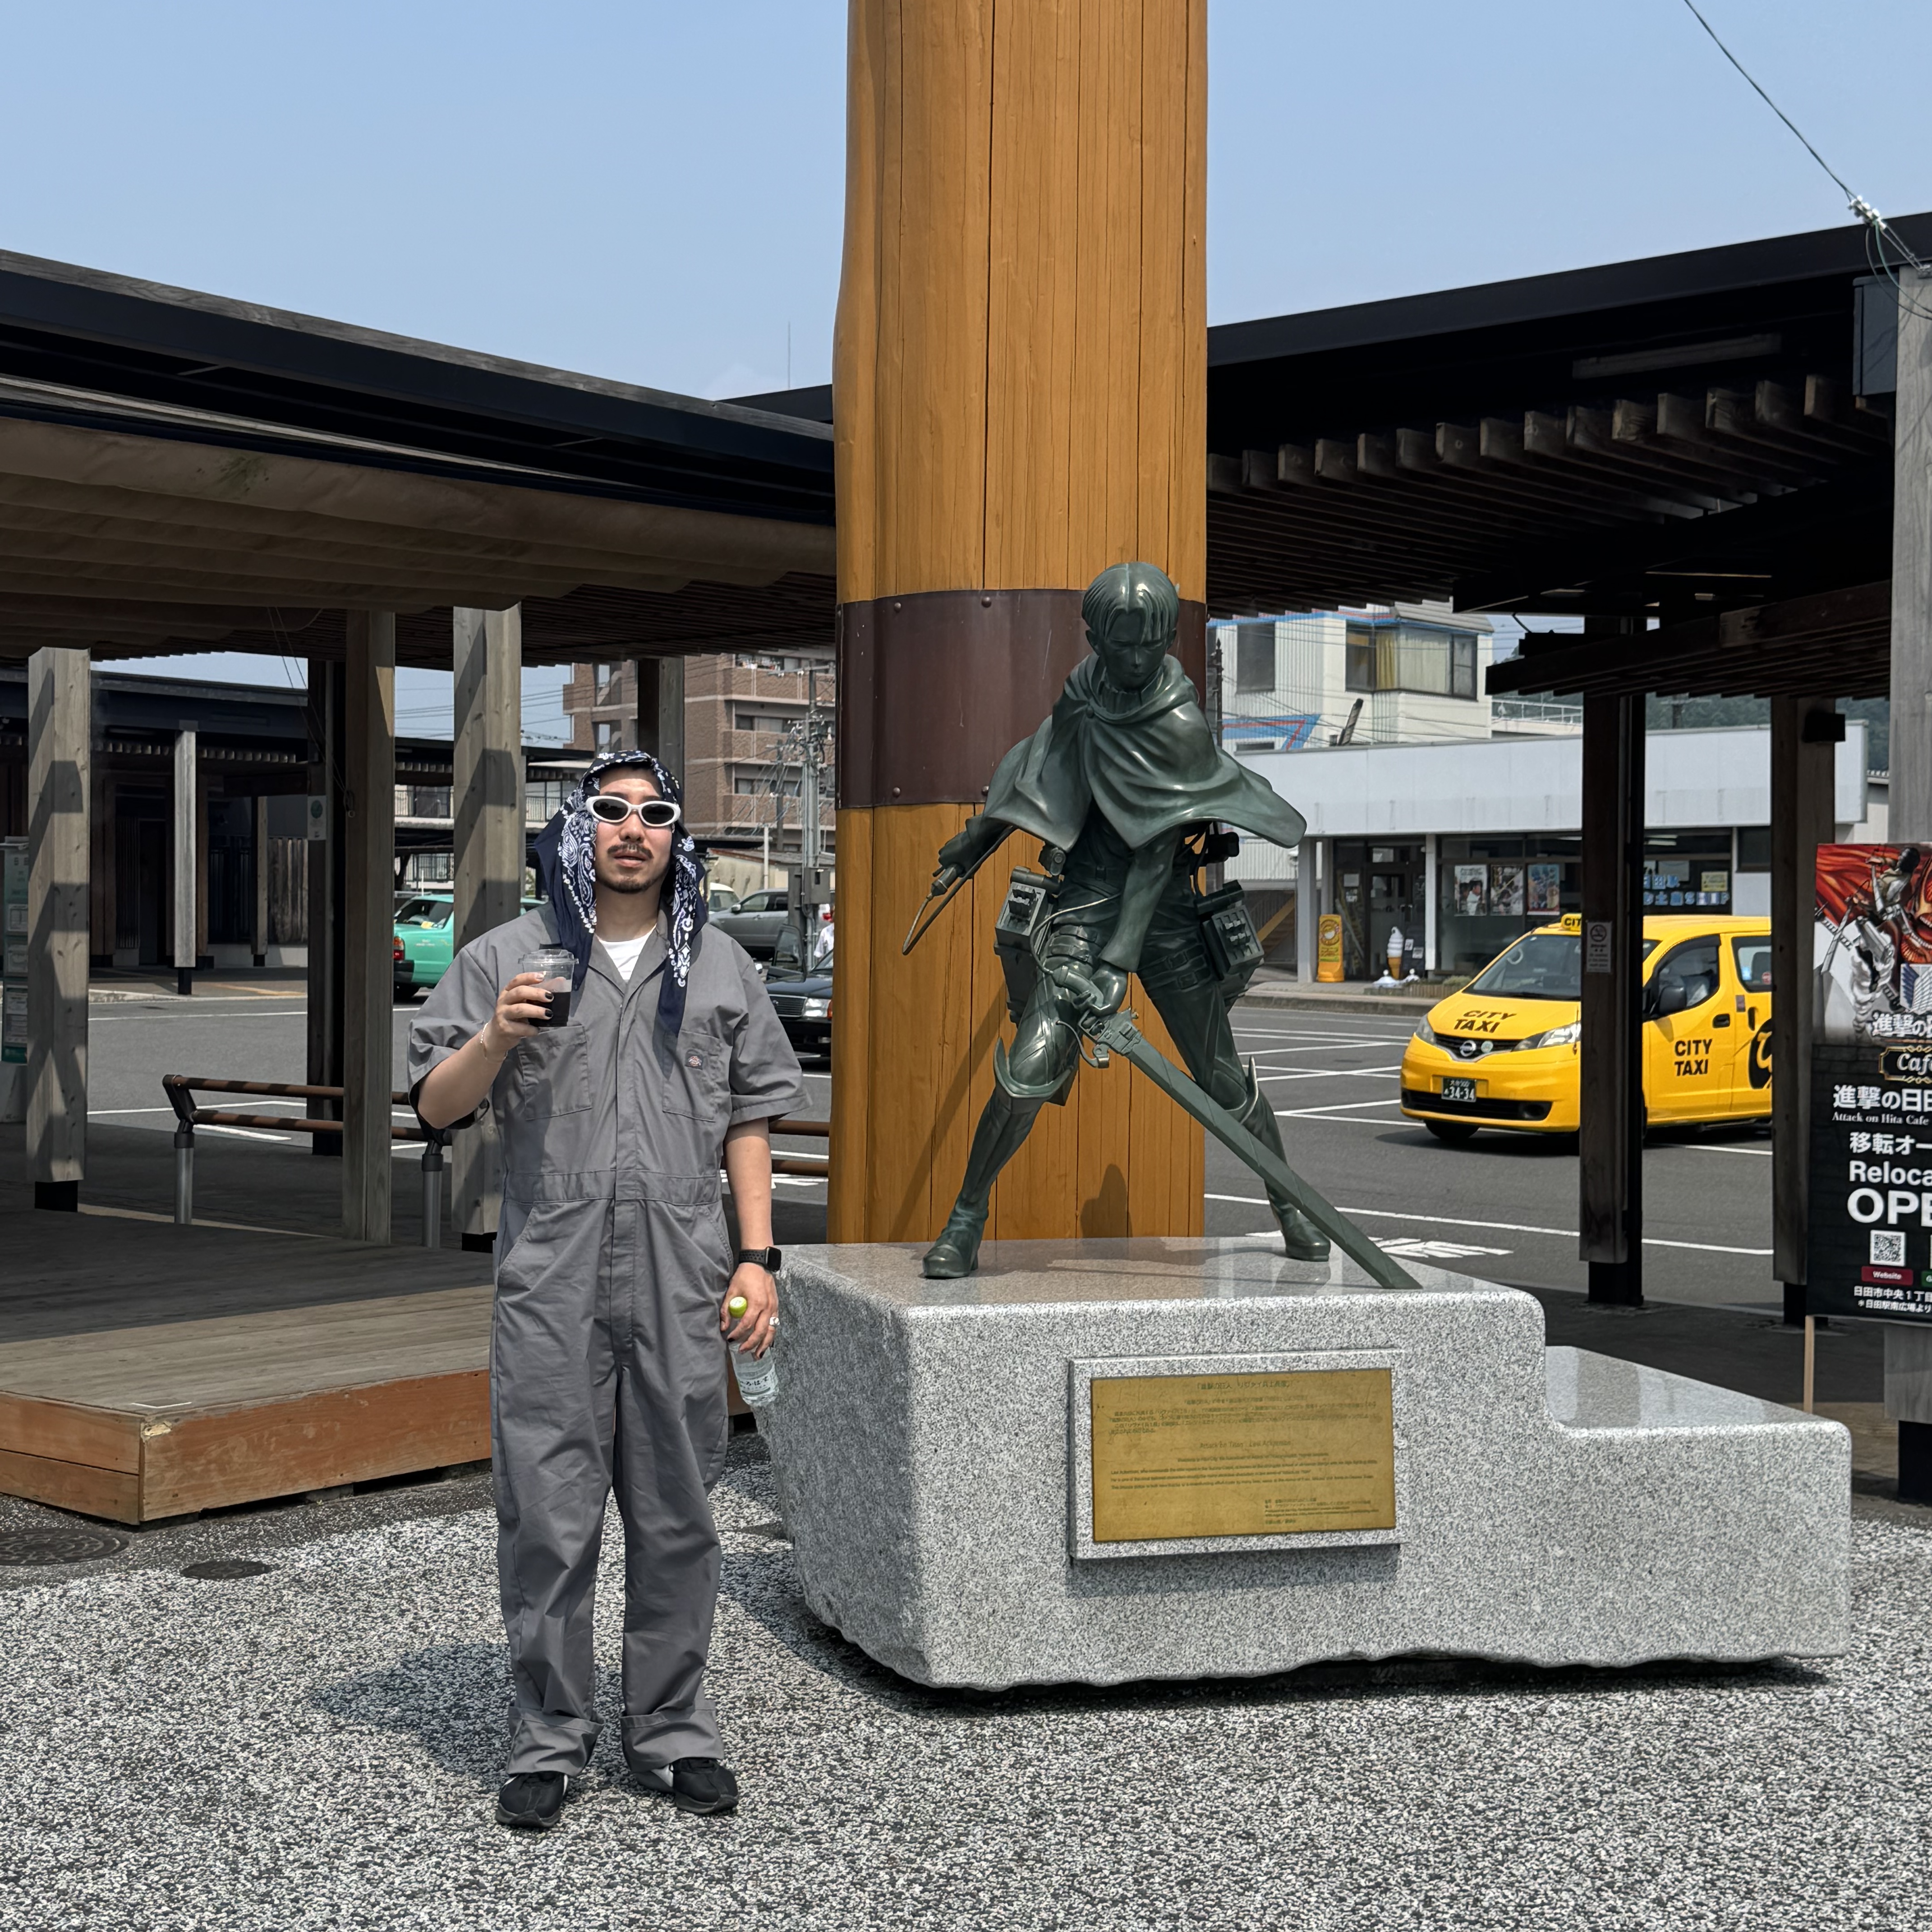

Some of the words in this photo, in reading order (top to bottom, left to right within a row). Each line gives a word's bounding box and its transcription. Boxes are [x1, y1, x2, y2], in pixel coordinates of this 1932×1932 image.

[1463, 1010, 1517, 1020] CITY
[1454, 1018, 1500, 1033] TAXI
[1674, 1039, 1713, 1057] CITY
[1674, 1058, 1709, 1076] TAXI
[1832, 1111, 1863, 1122] Attack
[1865, 1115, 1879, 1123] on
[1881, 1113, 1903, 1124] Hita
[1906, 1114, 1929, 1126] Cafe
[1849, 1160, 1932, 1187] Reloca
[1872, 1271, 1903, 1280] Website
